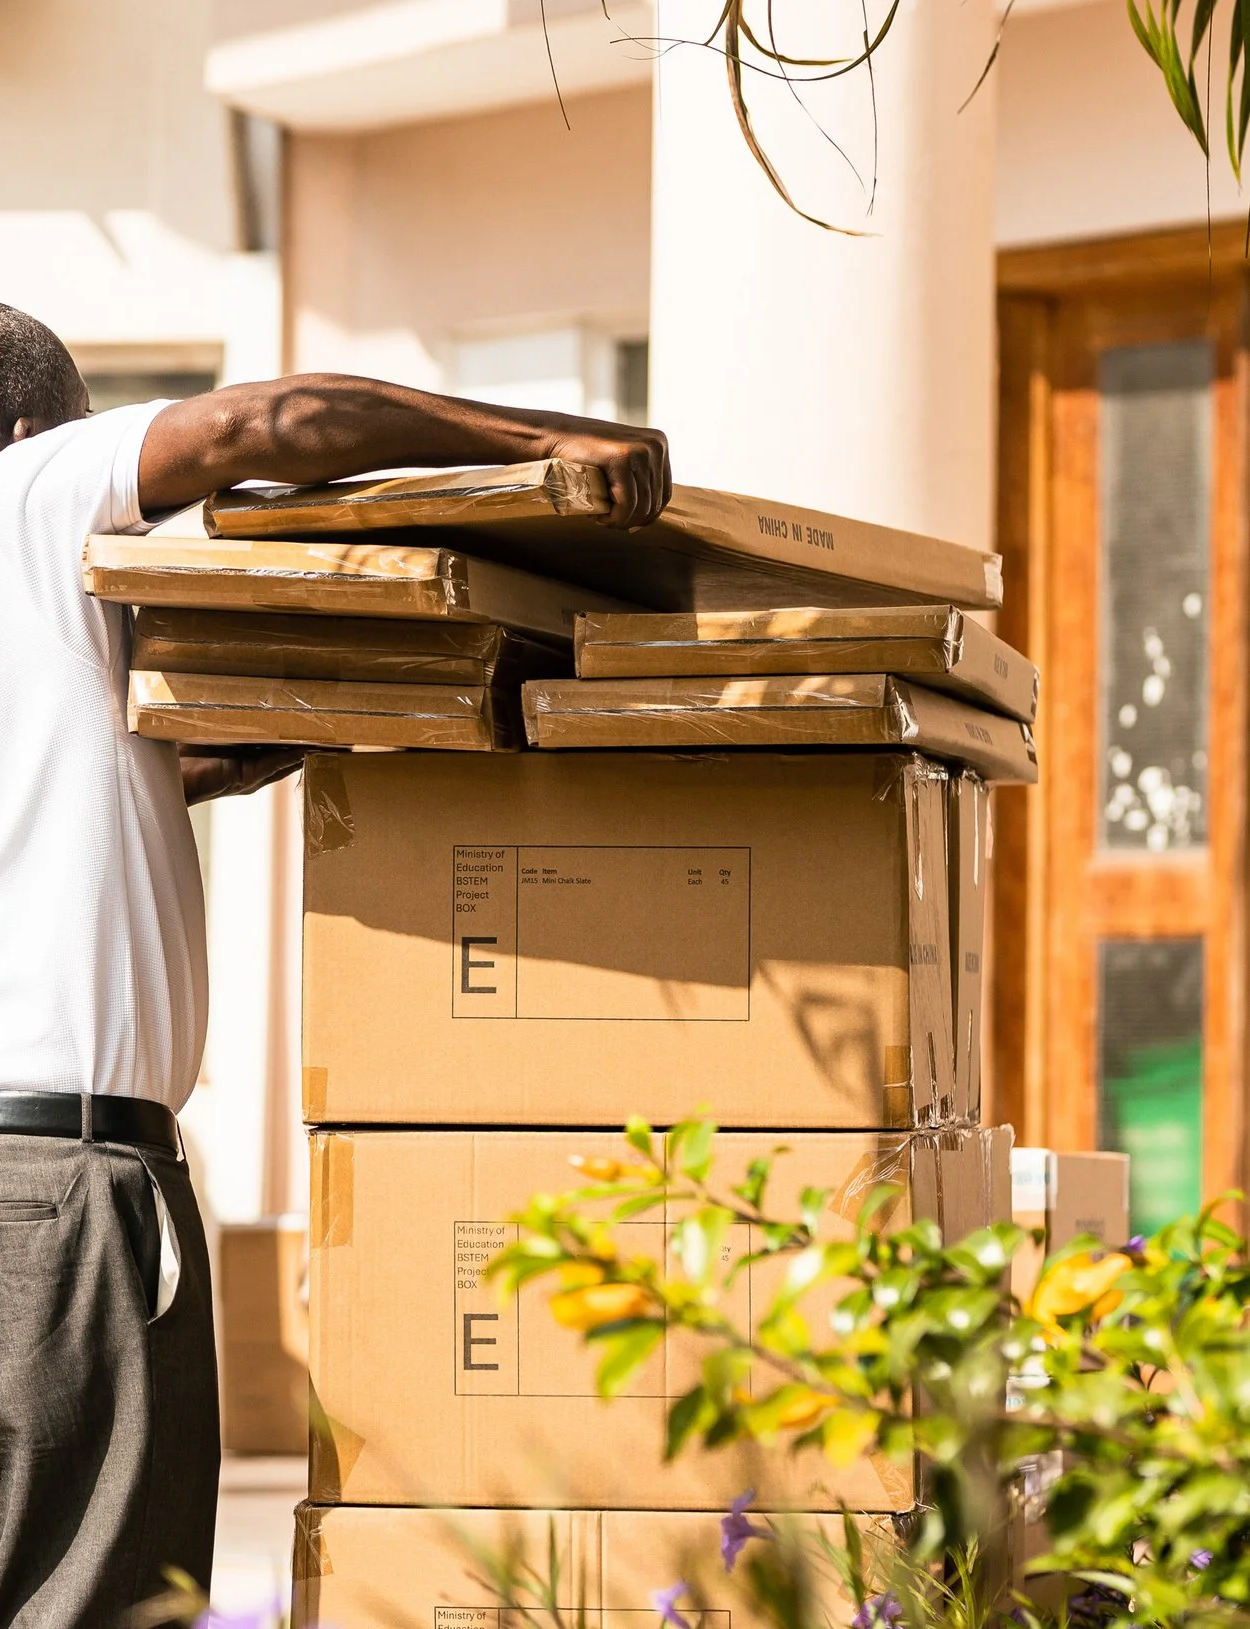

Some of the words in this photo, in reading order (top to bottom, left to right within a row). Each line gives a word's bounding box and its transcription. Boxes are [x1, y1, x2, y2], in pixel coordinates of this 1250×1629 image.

[758, 515, 787, 539] CHINA
[792, 523, 802, 542] IN
[806, 527, 834, 550] MADE
[456, 850, 494, 860] Ministry
[495, 850, 505, 859] of
[456, 863, 504, 872] Education
[718, 869, 731, 877] Qty
[456, 876, 489, 886] BSTEM
[575, 877, 592, 885] Slate
[456, 890, 489, 901] Project
[456, 904, 477, 913] BOX
[461, 936, 498, 994] E
[457, 1226, 494, 1236] Ministry
[495, 1226, 506, 1235] of
[457, 1240, 505, 1249] Education
[457, 1253, 489, 1262] BSTEM
[457, 1267, 489, 1277] Projec
[457, 1280, 478, 1289] BOX
[463, 1313, 499, 1371] E
[437, 1611, 475, 1622] Ministry
[476, 1611, 487, 1620] of
